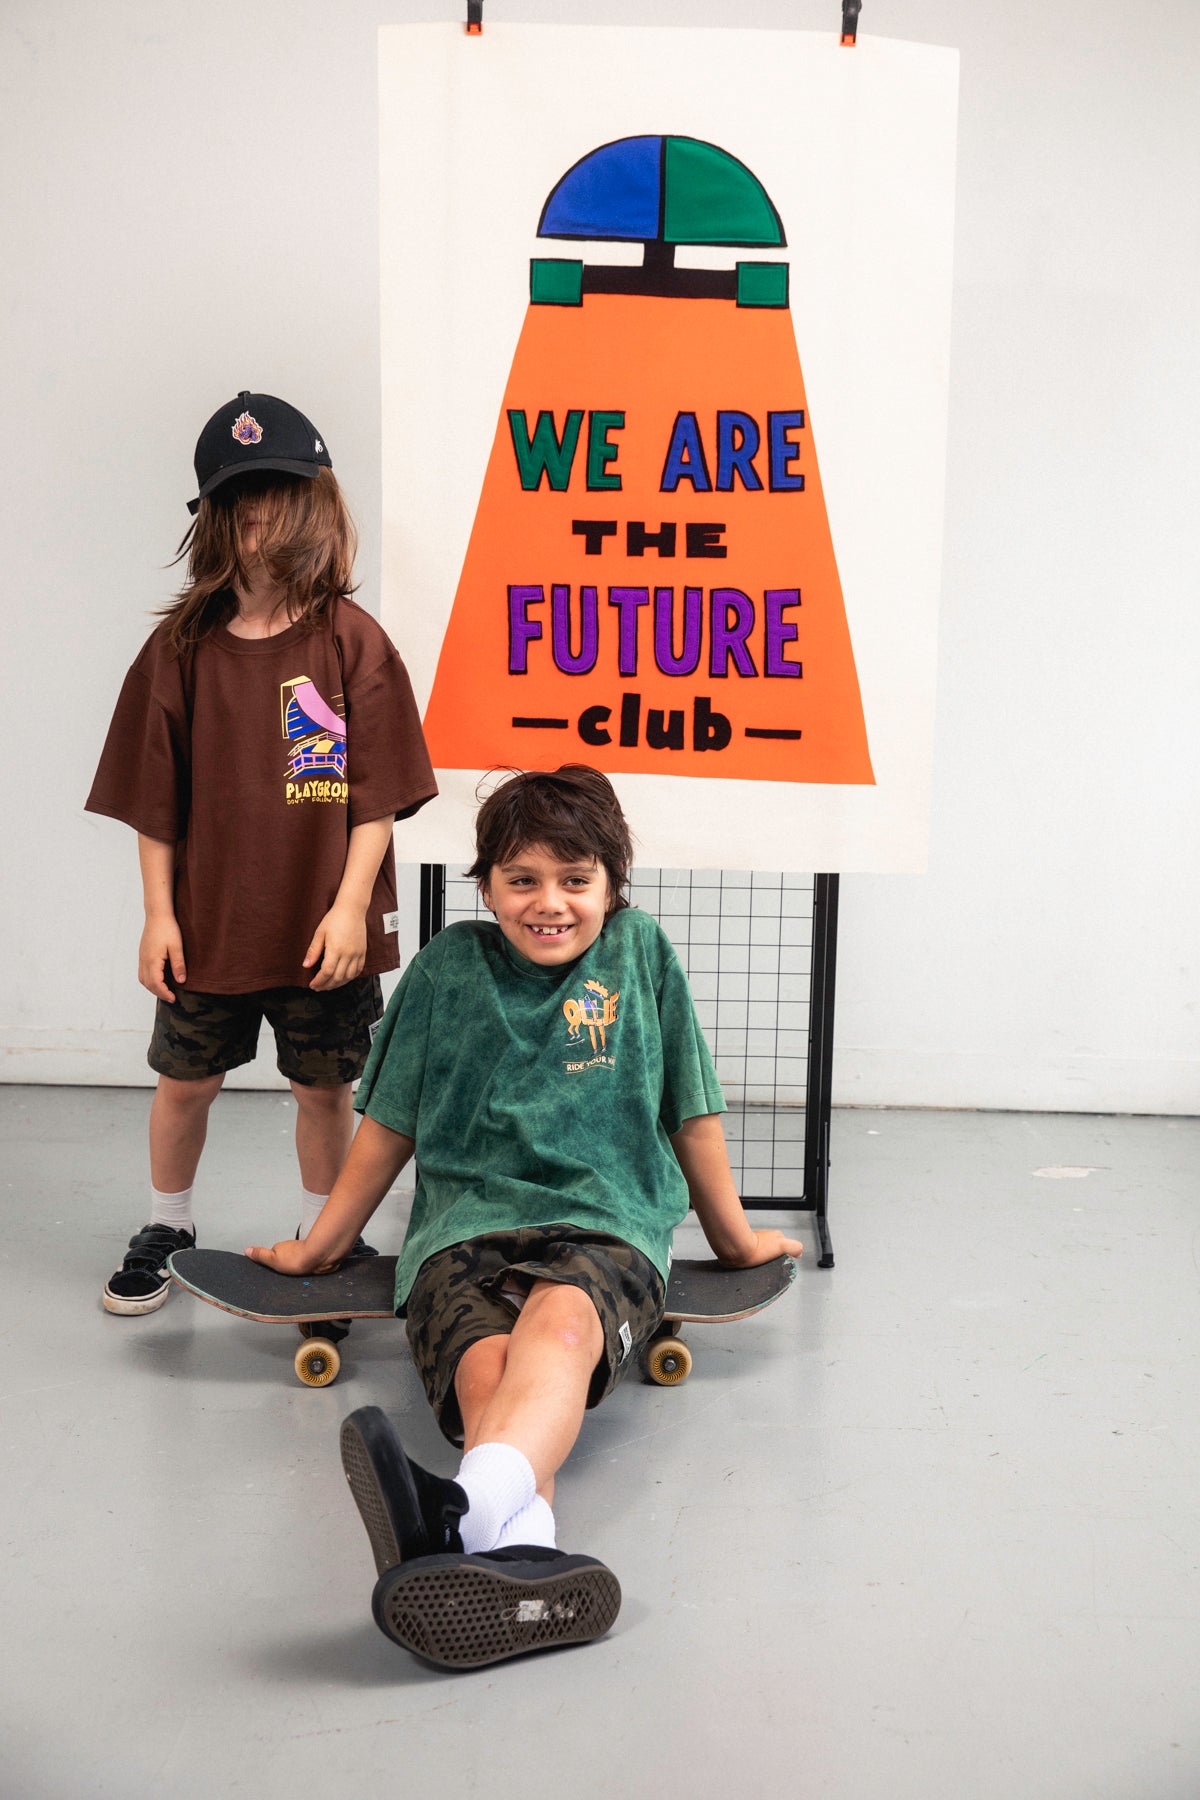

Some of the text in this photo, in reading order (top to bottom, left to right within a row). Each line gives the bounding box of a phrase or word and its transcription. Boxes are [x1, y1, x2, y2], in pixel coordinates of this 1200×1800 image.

[507, 409, 805, 493] WE ARE
[572, 520, 727, 558] THE
[507, 584, 803, 679] FUTURE
[577, 693, 732, 752] club
[567, 1063, 584, 1071] RIDE
[587, 1056, 606, 1066] YOUR
